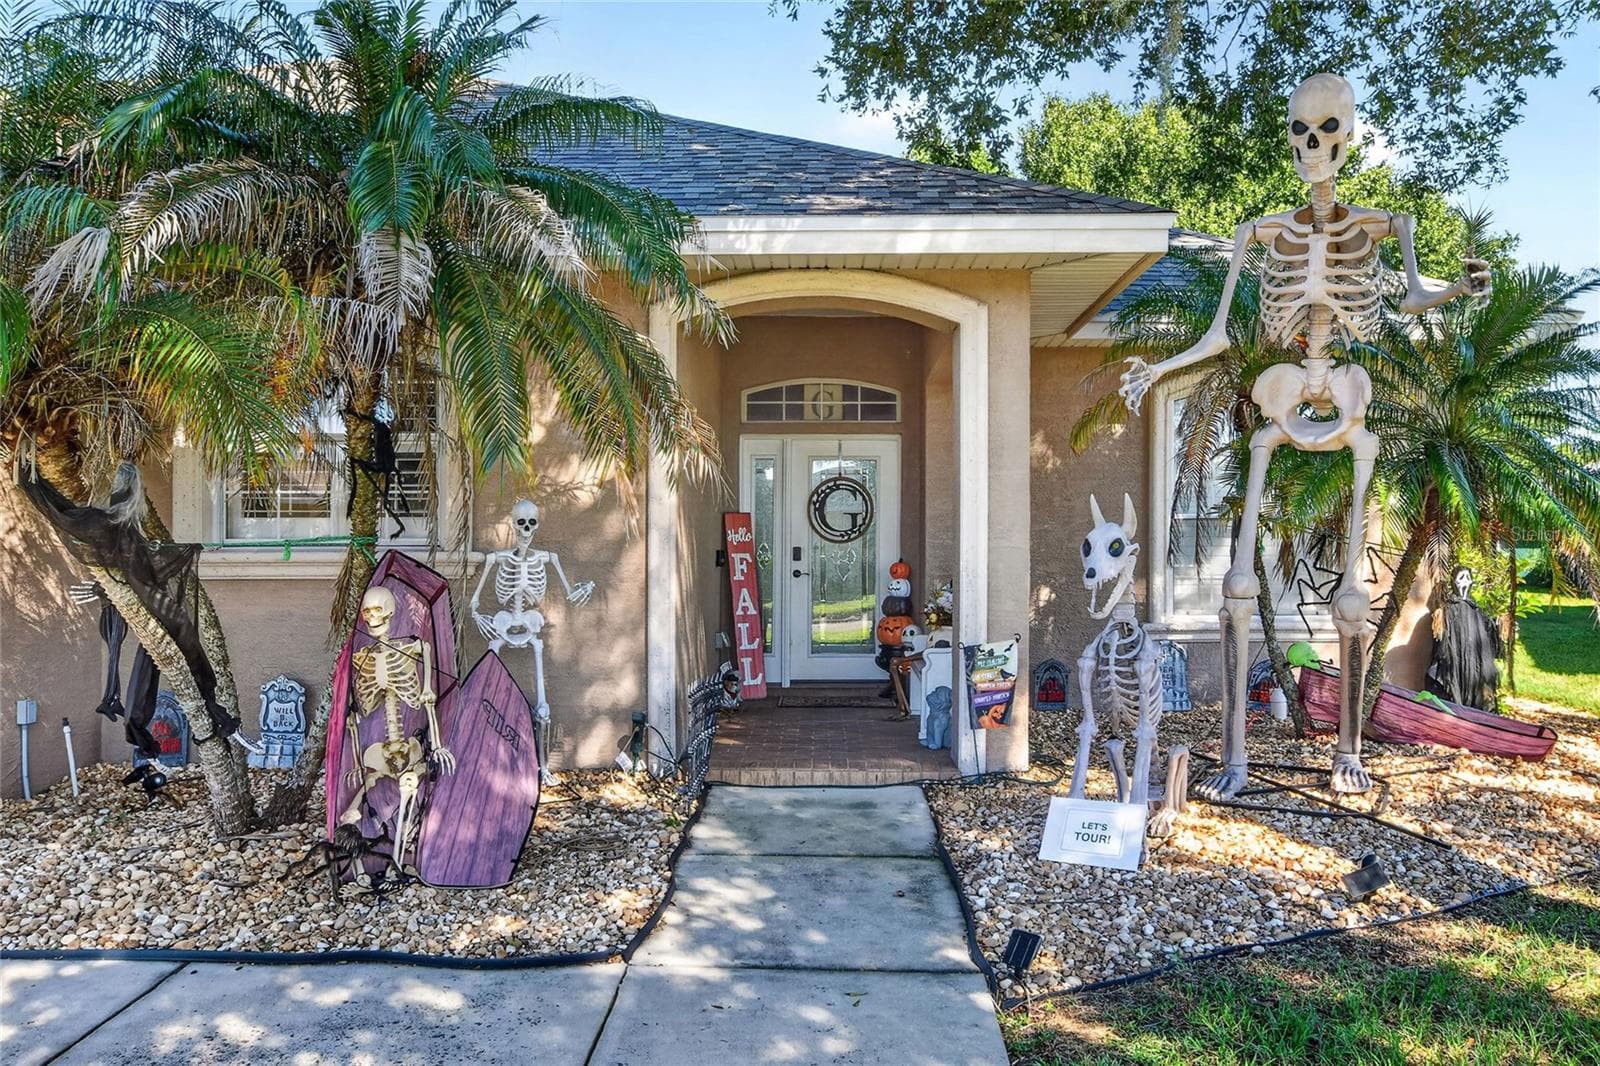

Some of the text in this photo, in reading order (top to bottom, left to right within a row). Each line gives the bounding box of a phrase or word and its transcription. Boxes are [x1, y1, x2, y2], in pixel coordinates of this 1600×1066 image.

[811, 390, 834, 419] G
[817, 486, 863, 533] G
[727, 527, 752, 545] Hello
[731, 552, 763, 686] FALL
[273, 707, 294, 715] WILL
[1081, 822, 1108, 831] LET'S
[1074, 832, 1111, 844] TOUR!
